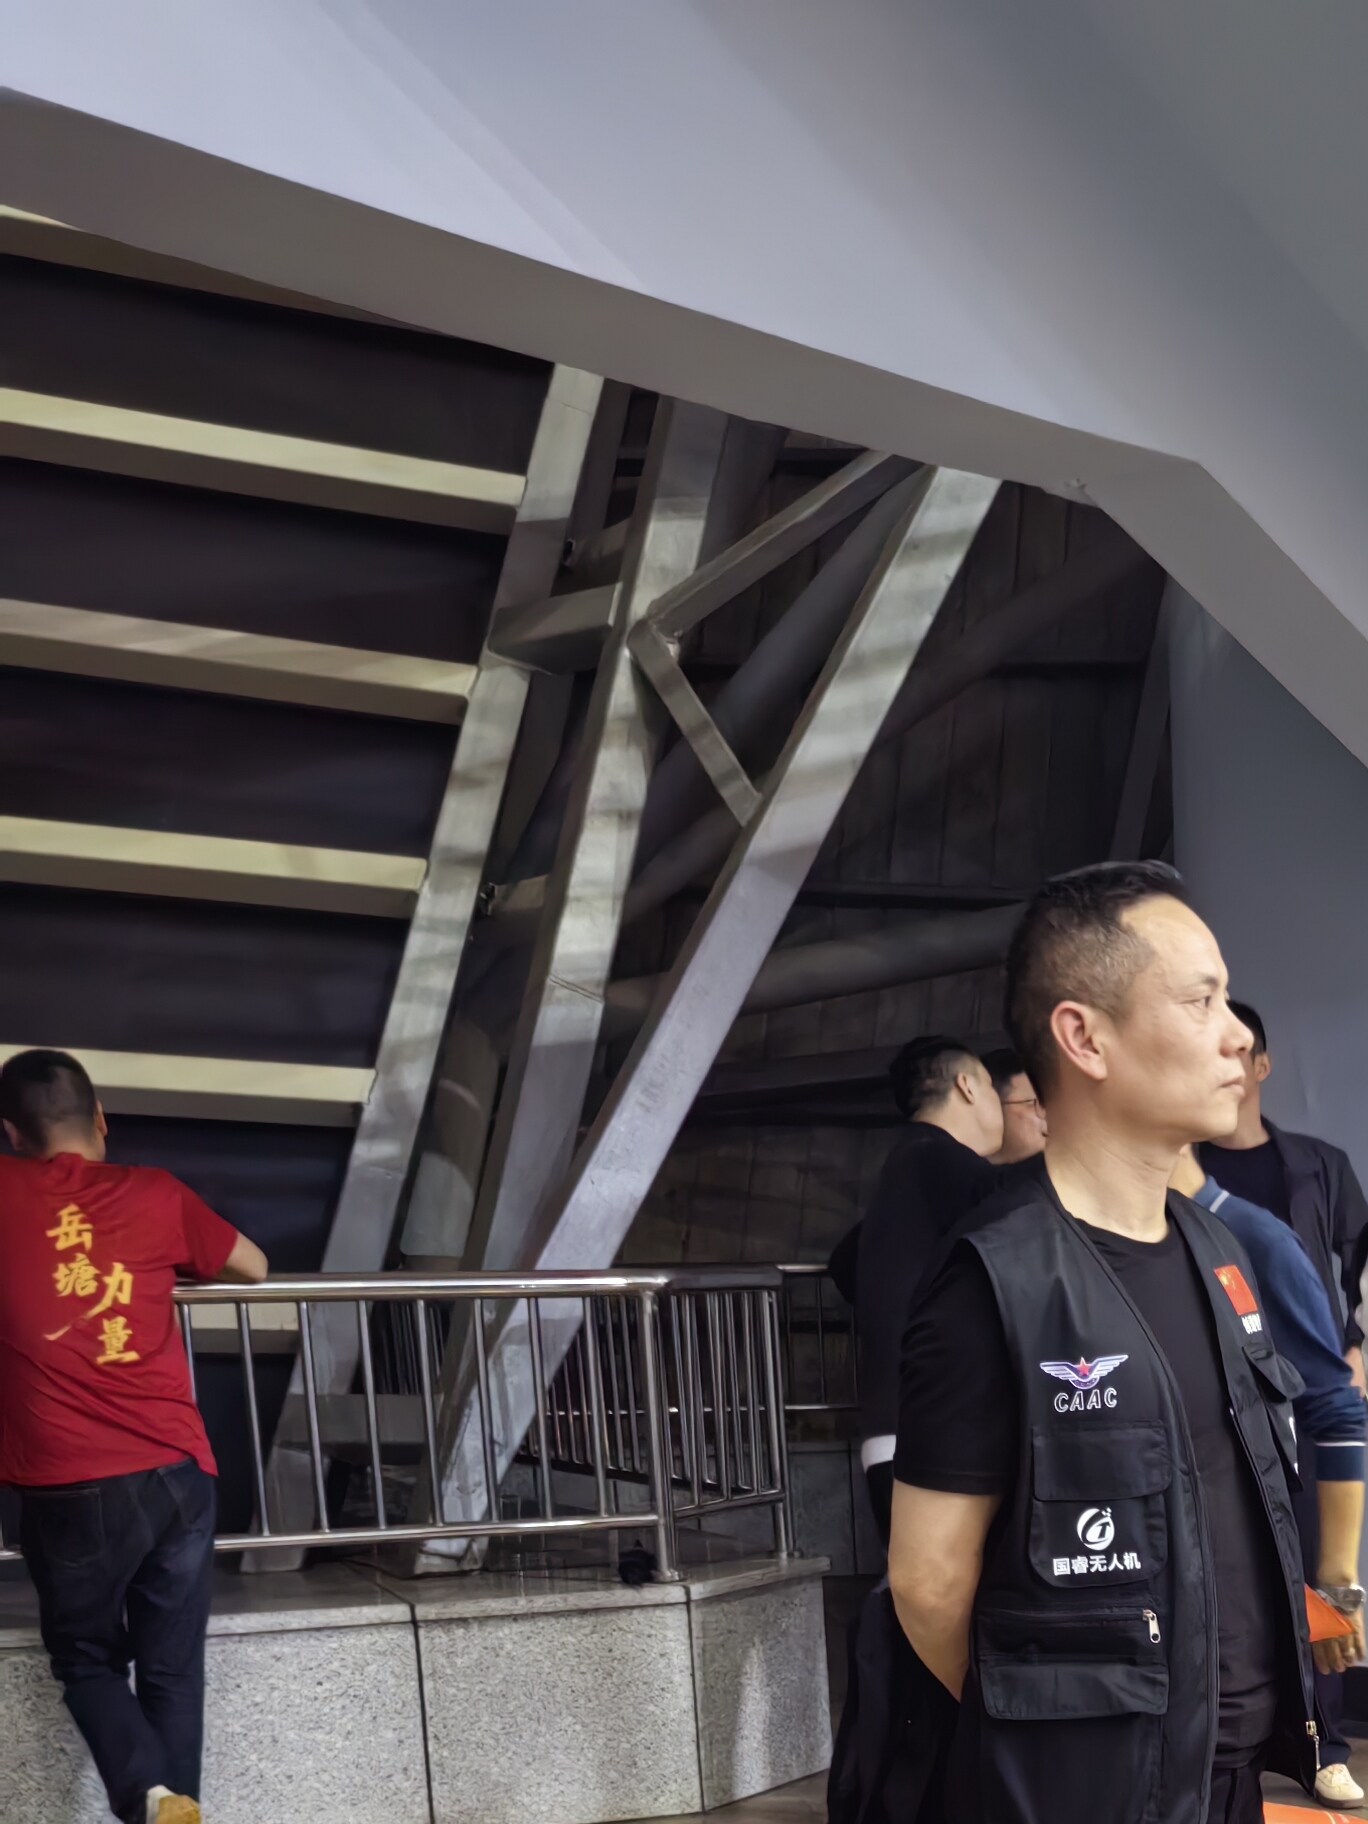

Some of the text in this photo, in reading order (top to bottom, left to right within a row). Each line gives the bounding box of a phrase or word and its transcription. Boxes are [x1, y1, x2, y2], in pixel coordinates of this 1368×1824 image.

[1054, 1387, 1118, 1412] CAAC
[1052, 1551, 1142, 1576] 国睿无人机
